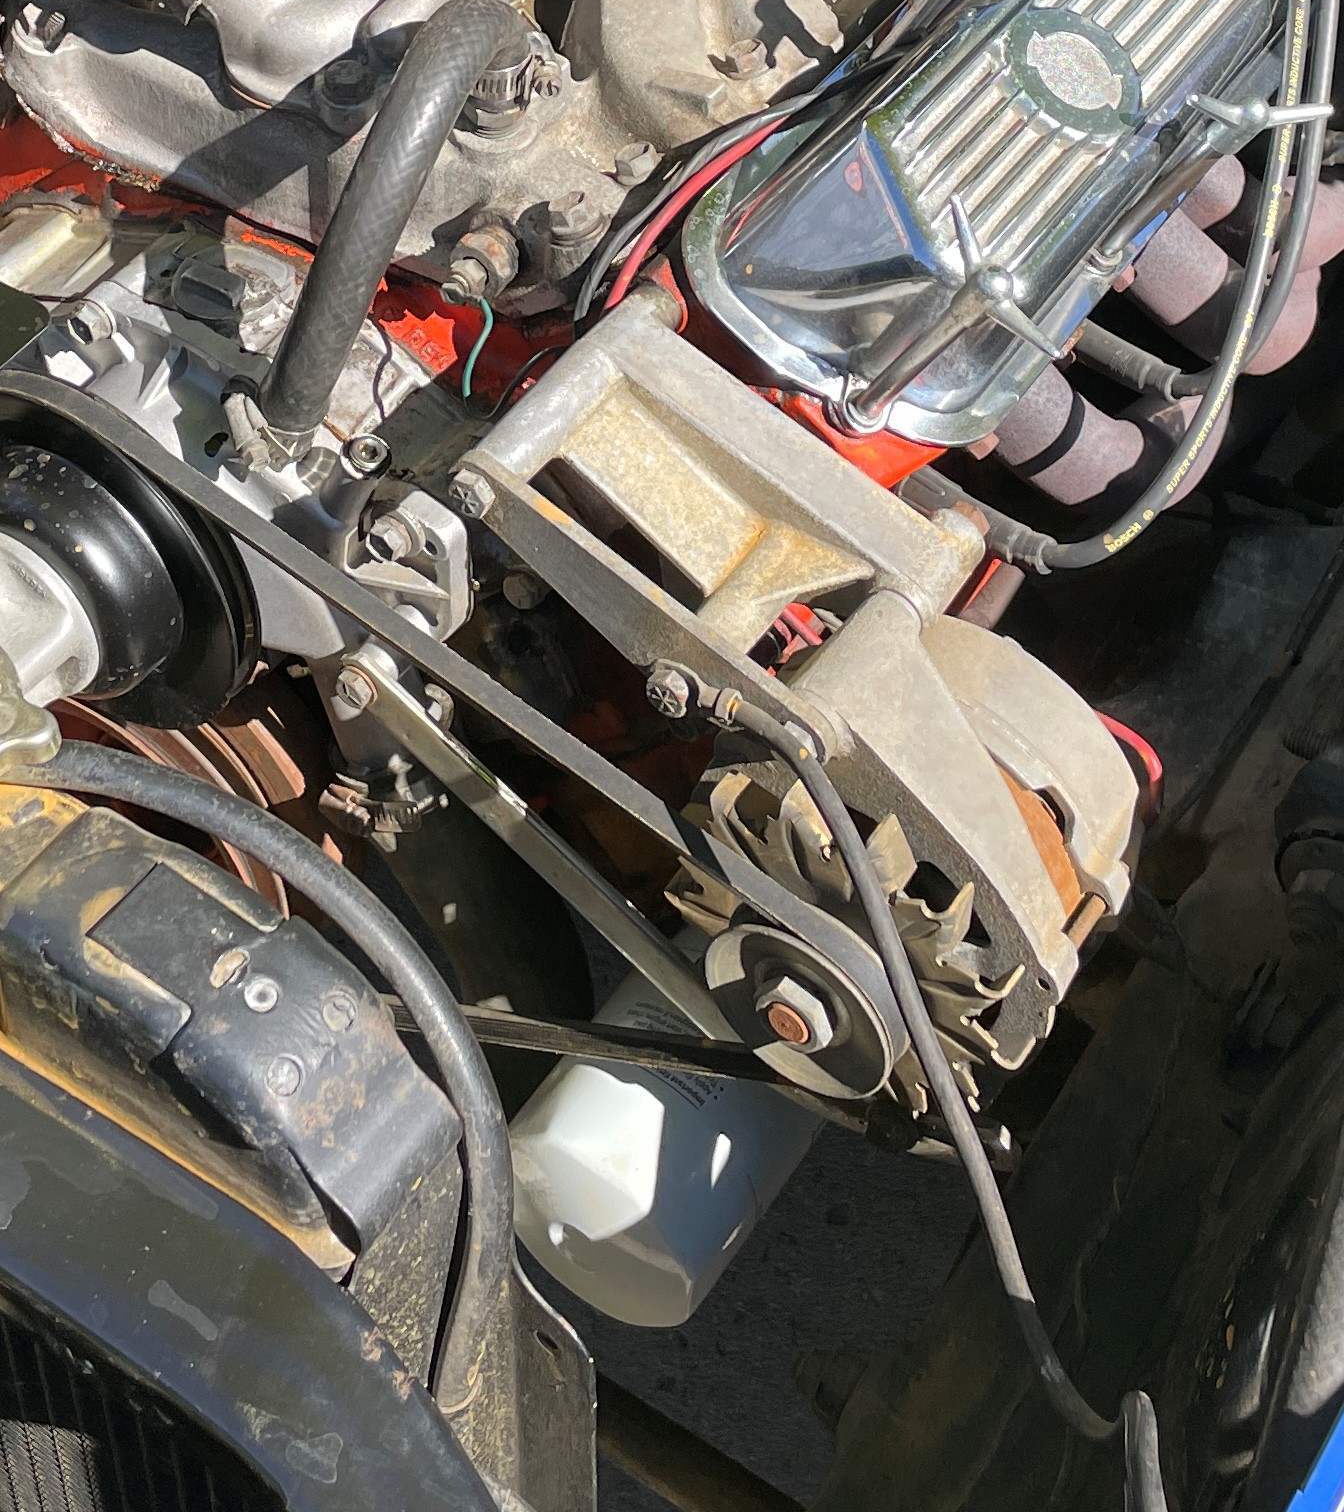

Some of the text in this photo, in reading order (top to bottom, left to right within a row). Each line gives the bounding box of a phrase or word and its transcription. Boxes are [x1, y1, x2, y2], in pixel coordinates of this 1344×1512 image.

[1295, 6, 1305, 35] CORE
[1289, 35, 1302, 88] INDUCTIVE
[1278, 127, 1291, 164] SUPER
[1166, 459, 1191, 494] SUPER
[1188, 418, 1213, 461] SPORTS
[1210, 360, 1237, 420] INDUCTIVE
[1105, 522, 1142, 553] BOSCH
